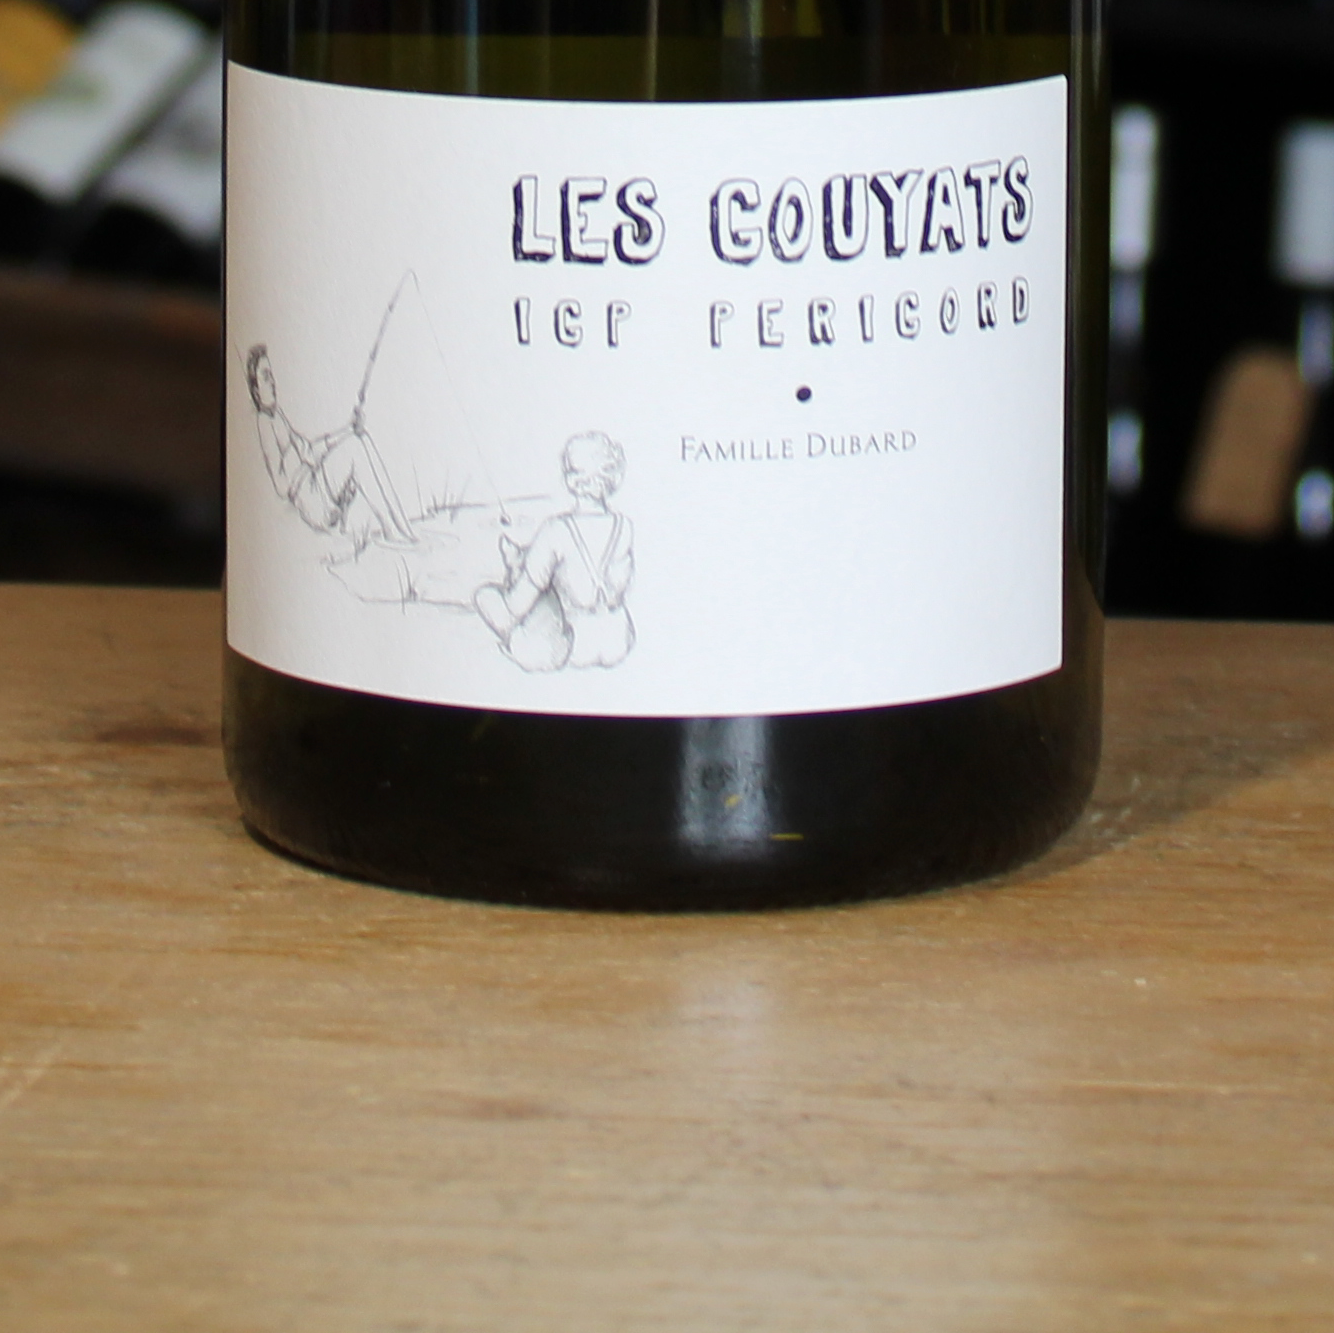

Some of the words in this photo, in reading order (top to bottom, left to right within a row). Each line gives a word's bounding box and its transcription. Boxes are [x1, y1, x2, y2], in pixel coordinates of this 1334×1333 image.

[511, 174, 666, 267] LES
[709, 154, 1034, 265] GOUYATS
[513, 296, 633, 349] IGP
[709, 275, 1031, 349] PERIGORD
